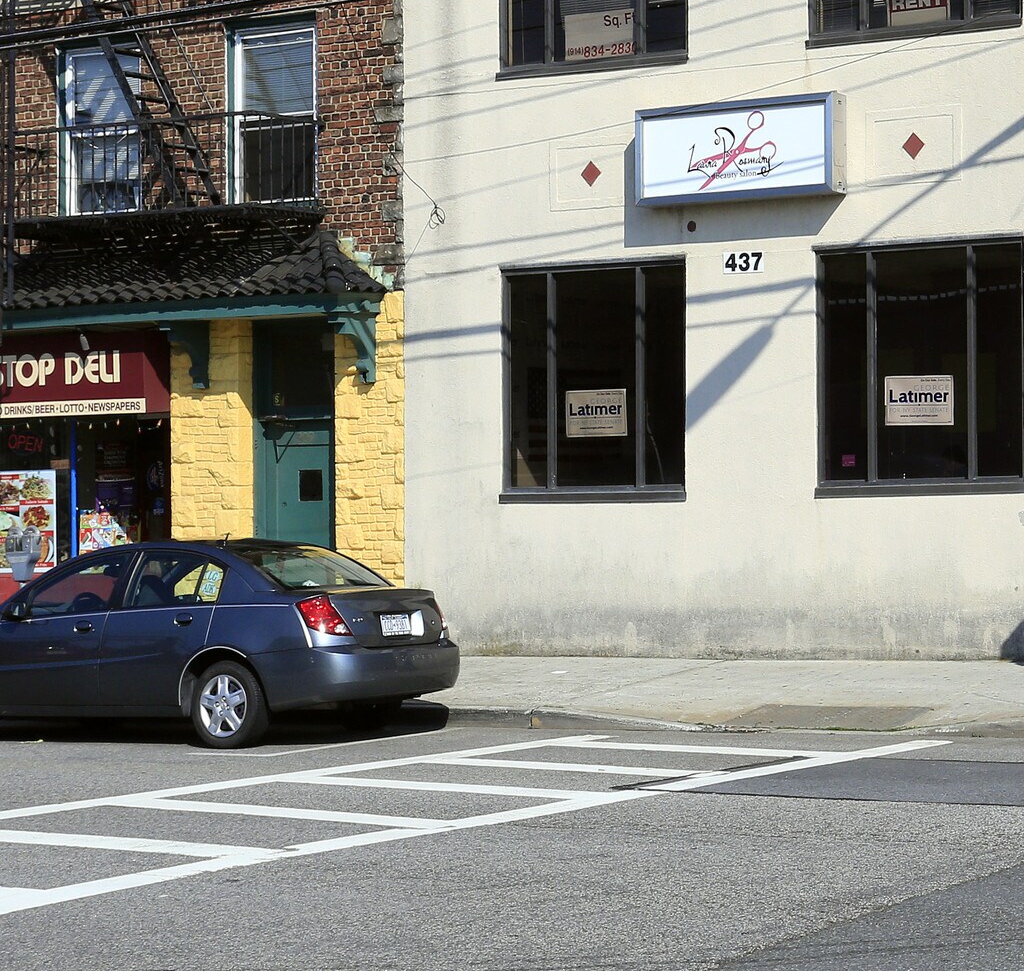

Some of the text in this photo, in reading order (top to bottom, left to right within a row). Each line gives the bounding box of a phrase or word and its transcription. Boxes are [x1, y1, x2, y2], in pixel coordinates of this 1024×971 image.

[603, 15, 622, 28] Sq.
[725, 252, 762, 272] 437
[0, 350, 121, 388] TOP DELI
[889, 389, 949, 403] Latimer
[88, 401, 141, 412] NEWSPAPERS
[569, 403, 622, 416] Latimer
[8, 434, 44, 452] OPEN
